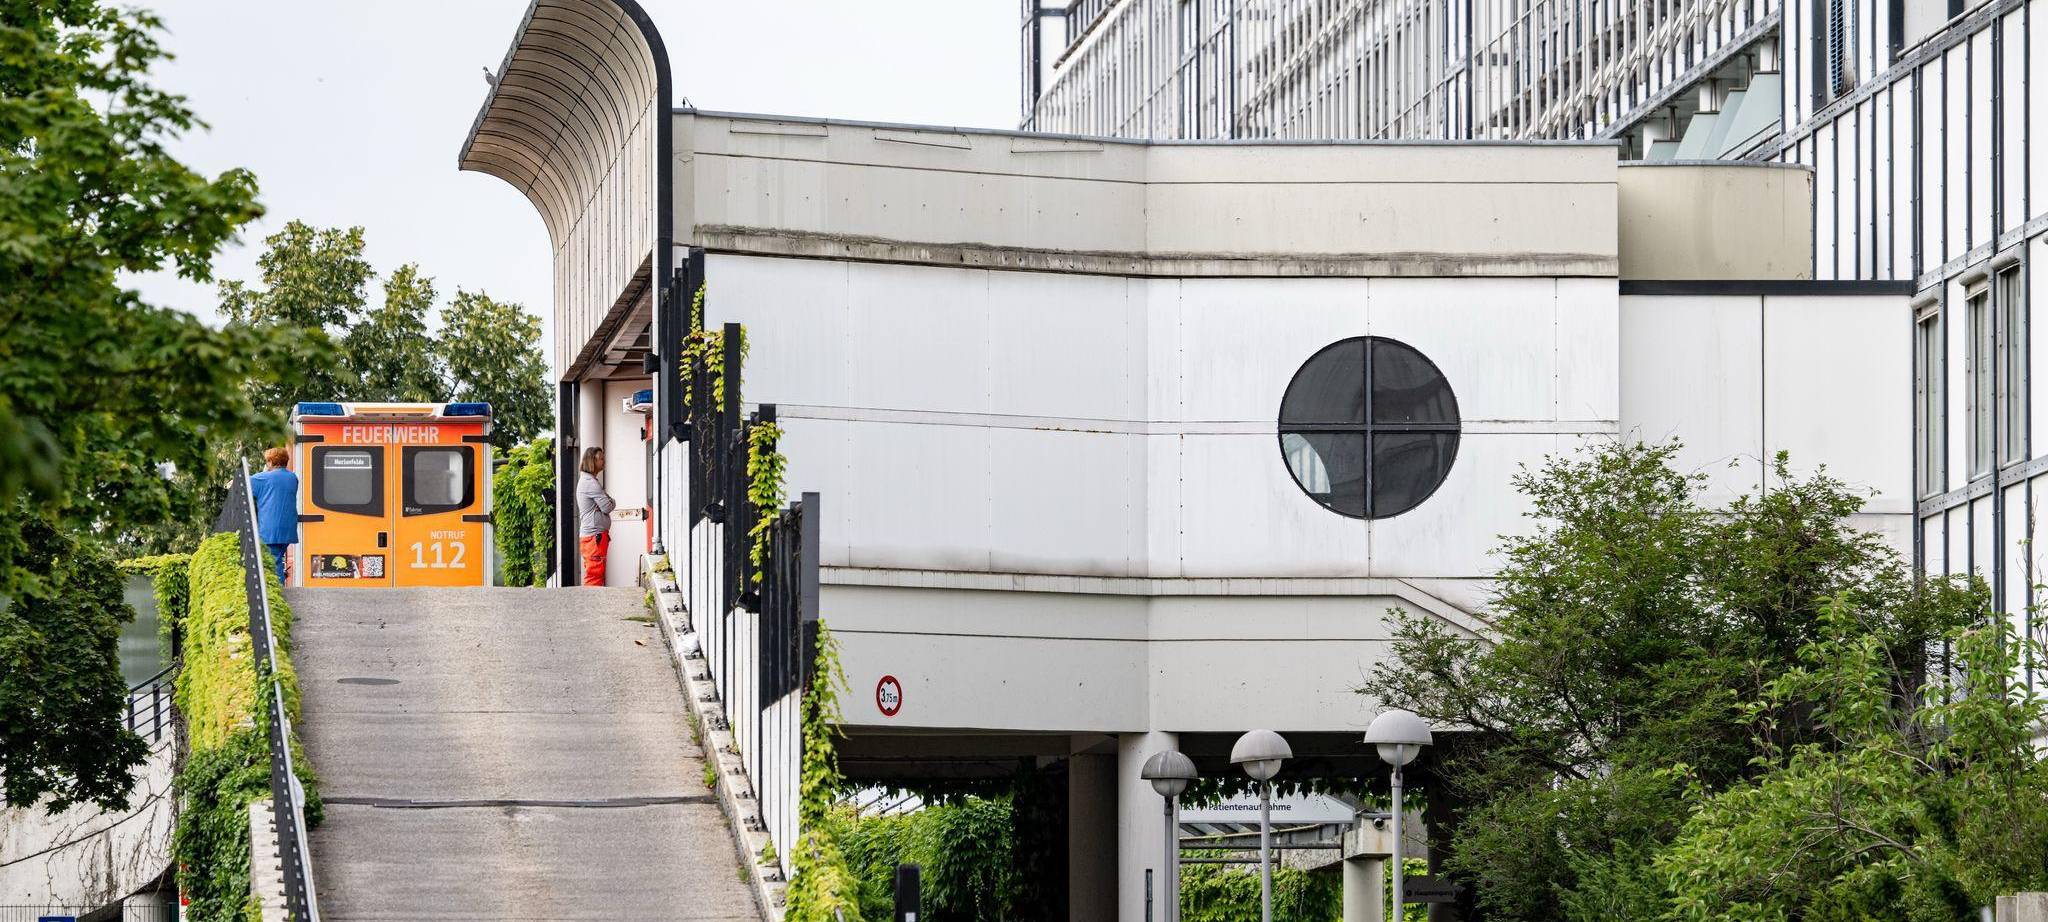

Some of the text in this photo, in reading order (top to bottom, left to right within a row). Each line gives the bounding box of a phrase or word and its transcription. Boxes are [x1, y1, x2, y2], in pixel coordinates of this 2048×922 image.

[343, 426, 439, 443] FEUERWEHR
[431, 530, 464, 539] NOTRUF
[411, 542, 465, 568] 112
[1208, 802, 1291, 811] Patientenaufahme
